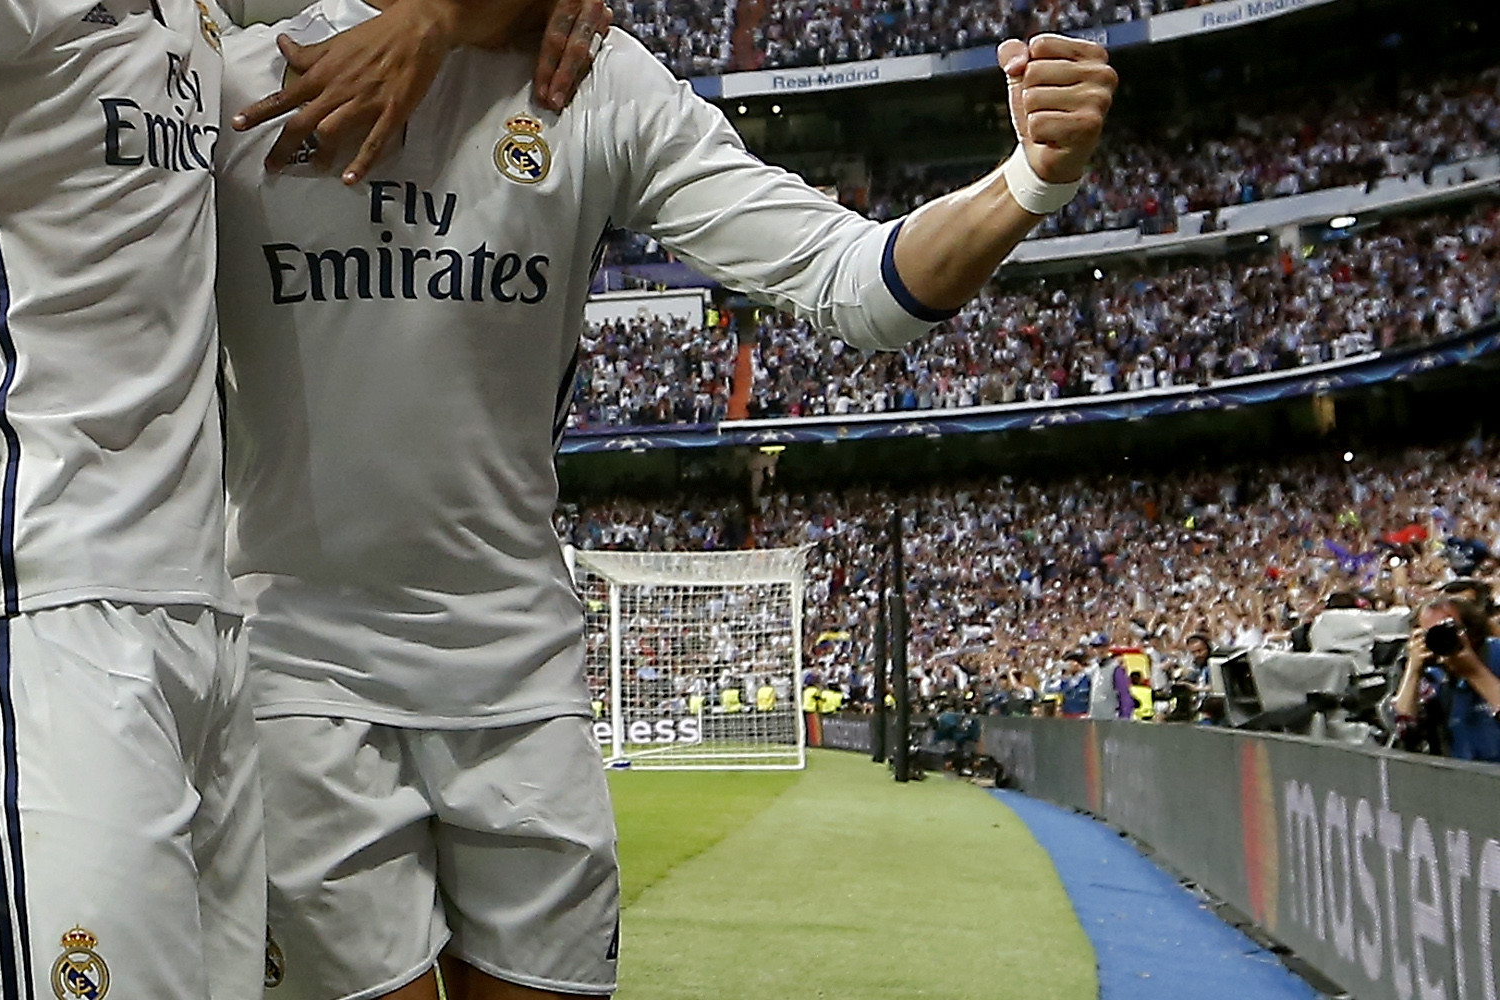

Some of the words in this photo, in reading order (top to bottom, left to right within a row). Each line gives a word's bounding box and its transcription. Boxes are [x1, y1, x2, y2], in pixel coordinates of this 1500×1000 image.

[1202, 4, 1243, 27] Real
[772, 74, 812, 89] Real
[817, 66, 880, 86] Madrid
[367, 180, 457, 236] Fly
[261, 231, 550, 304] Emirates
